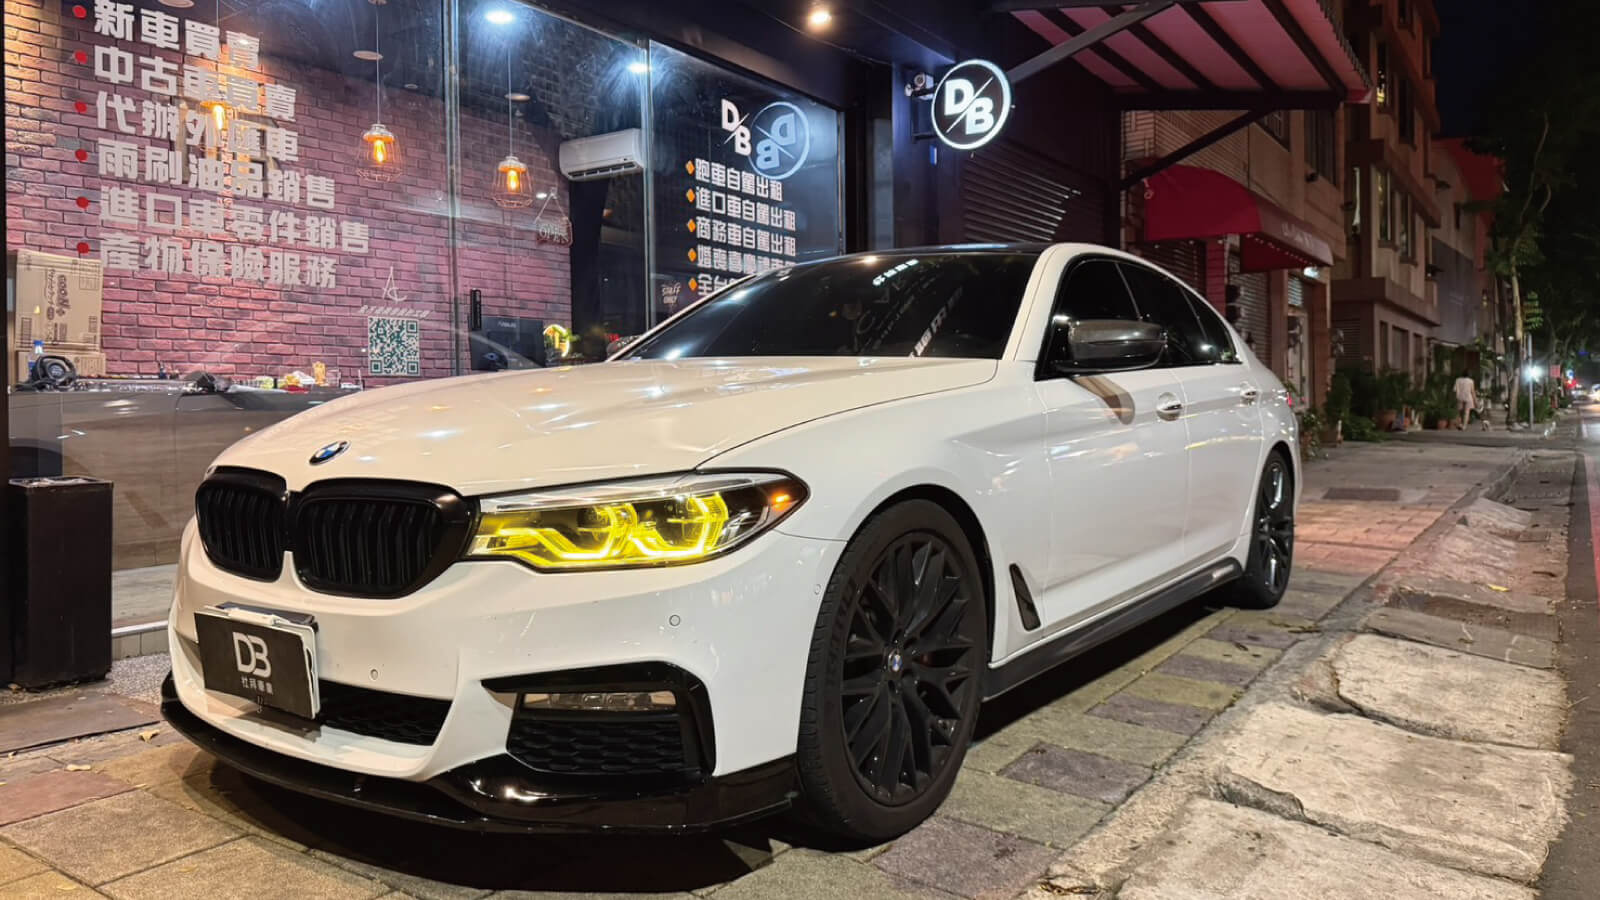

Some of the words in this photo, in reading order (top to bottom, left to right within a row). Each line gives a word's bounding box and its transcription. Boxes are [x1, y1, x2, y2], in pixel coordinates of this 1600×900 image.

[94, 0, 260, 70] 新車買賣
[94, 45, 296, 122] 中古車買賣
[96, 91, 299, 162] 代辦外匯車
[97, 137, 335, 209] 雨刷油品銷售
[99, 186, 370, 254] 進口車零件銷售
[696, 186, 796, 231] 進口車自駕出租
[696, 216, 796, 257] 商務車自駕出租
[99, 232, 337, 289] 產物保險服務
[233, 631, 271, 678] DB
